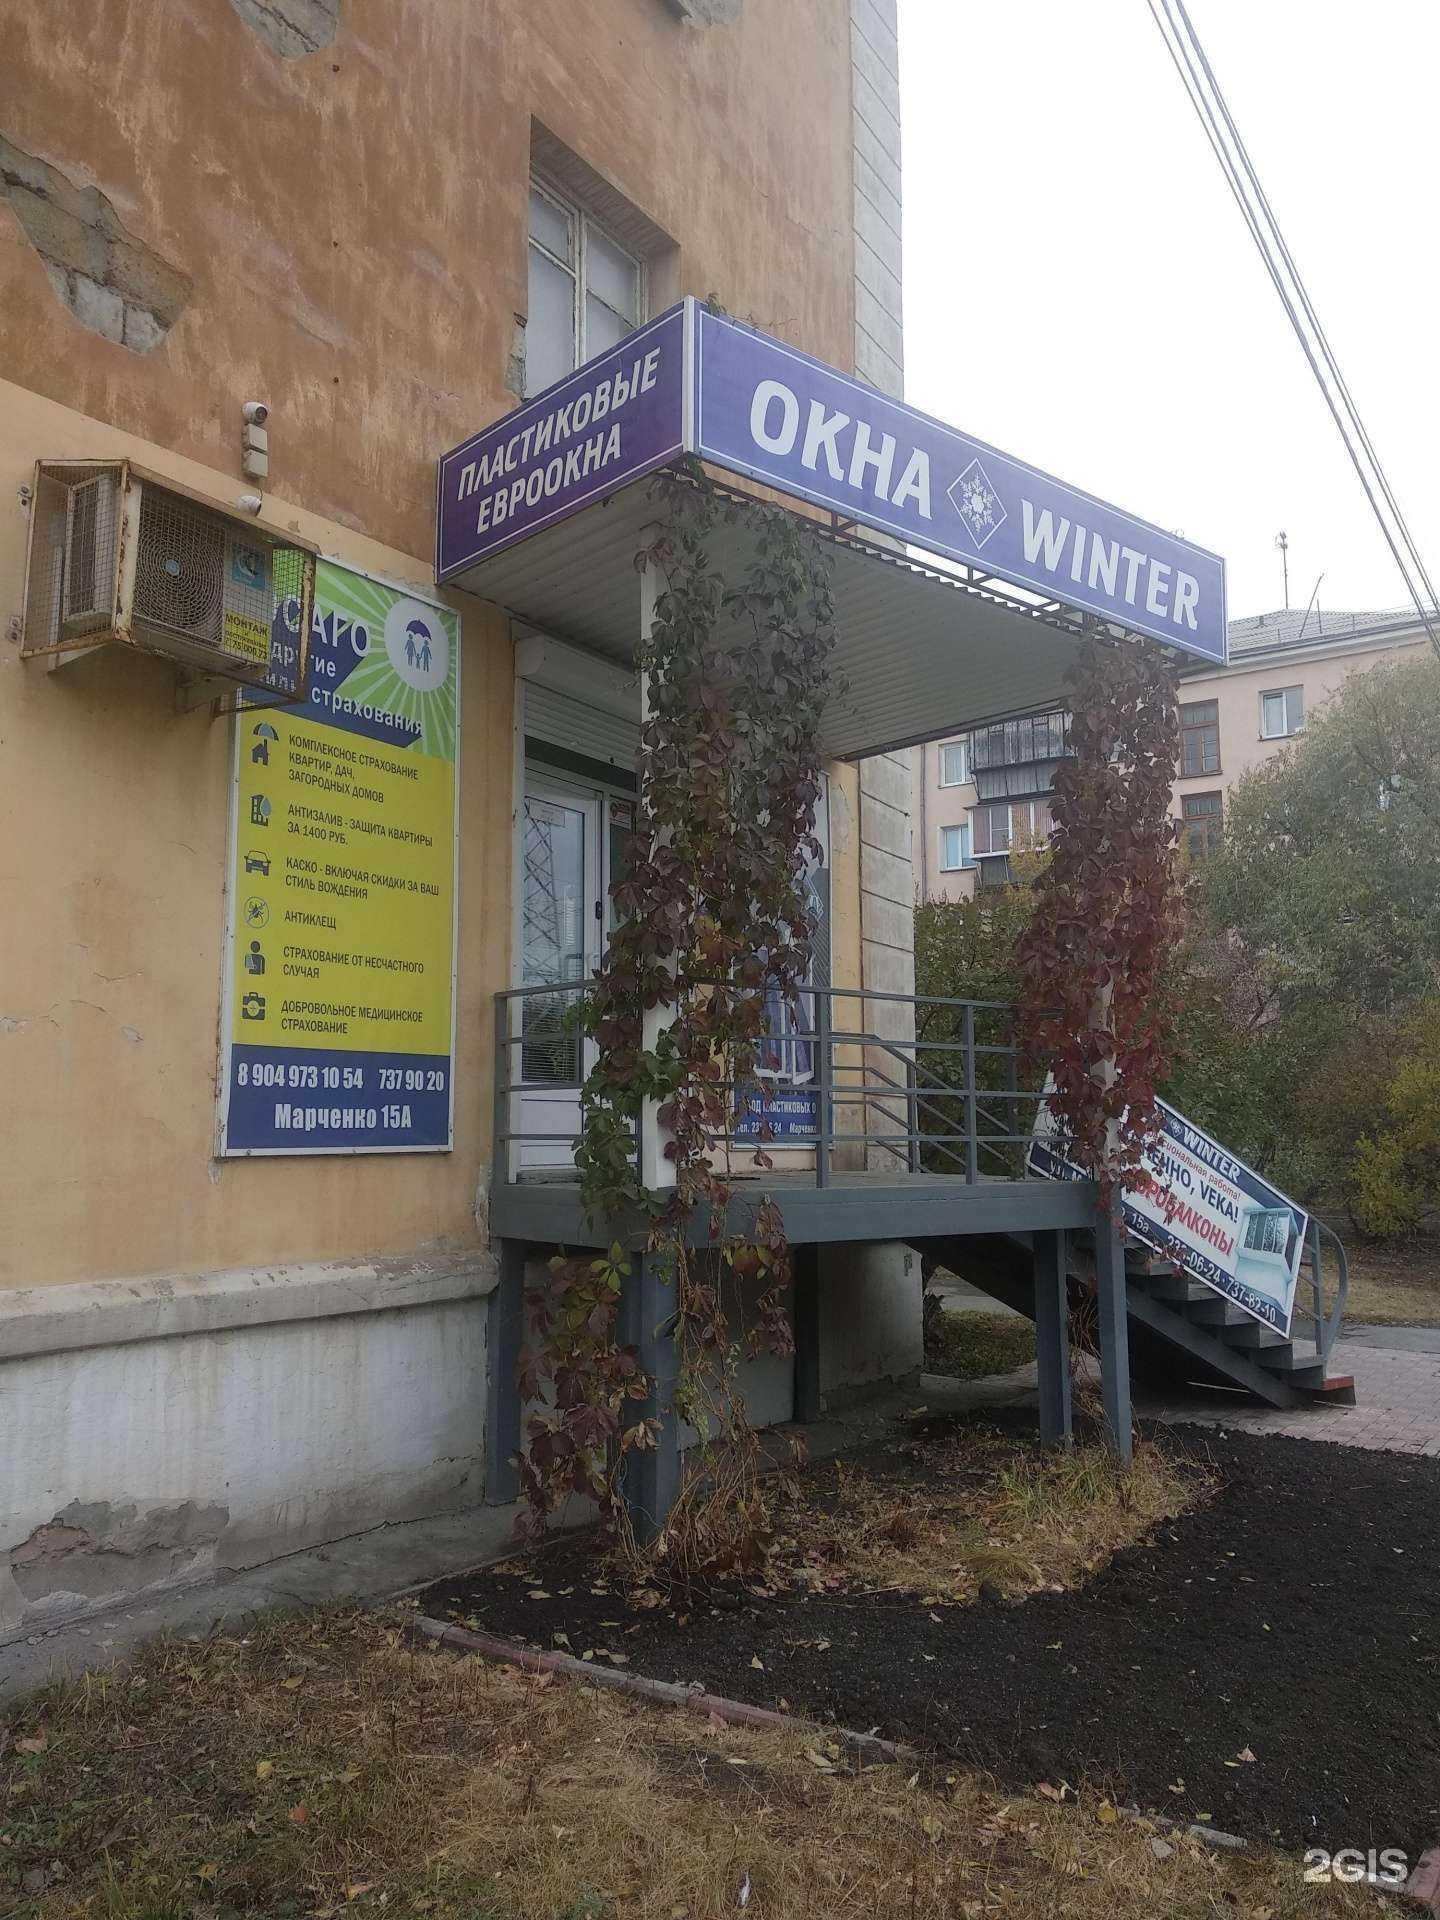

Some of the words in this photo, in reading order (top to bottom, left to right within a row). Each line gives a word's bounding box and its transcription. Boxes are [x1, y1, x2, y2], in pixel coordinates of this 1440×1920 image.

[458, 346, 661, 501] ПЛАСТИКОВЫЕ
[477, 423, 621, 534] ЕВРООКНА
[749, 379, 933, 520] ОКНА
[1021, 499, 1200, 630] WINTER
[311, 686, 422, 734] страхования
[289, 734, 356, 763] КОМПЛЕКСНОЕ
[359, 754, 419, 780] СТРАХОВАНИЕ
[289, 752, 333, 775] КВАРТИР,
[288, 769, 350, 795] ЗАГОРОДНЫХ
[352, 786, 384, 803] ДОМОВ
[288, 804, 342, 827] АНТИЗАЛИВ
[350, 818, 386, 835] ЗАЩИТА
[388, 828, 433, 847] КВАРТИРЫ
[288, 821, 300, 834] ЗА
[303, 825, 327, 840] 1400
[329, 830, 348, 845] РУБ.
[285, 874, 316, 891] СТИЛЬ
[318, 881, 368, 899] ВОЖДЕНИЯ
[286, 856, 317, 873] КАСКО
[325, 865, 369, 883] ВКЛЮЧАЯ
[371, 873, 406, 890] СКИДКИ
[408, 881, 418, 892] ЗА
[421, 883, 439, 896] ВАШ
[284, 910, 336, 930] АНТИКЛЕЩ
[283, 946, 349, 965] СТРАХОВАНИЕ
[352, 955, 363, 966] ОТ
[365, 957, 424, 974] НЕСЧАСТНОГО
[283, 964, 319, 978] СЛУЧАЯ
[281, 1000, 356, 1017] ДОБРОВОЛЬНОЕ
[359, 1007, 423, 1023] МЕДИЦИНСКОЕ
[281, 1018, 348, 1034] СТРАХОВАНИЕ
[237, 1063, 248, 1086] 8
[252, 1064, 285, 1087] 904
[289, 1065, 318, 1088] 973
[322, 1067, 340, 1089] 10
[343, 1068, 363, 1089] 54
[379, 1069, 402, 1090] 737
[405, 1070, 424, 1091] 90
[427, 1071, 444, 1092] 20
[274, 1103, 376, 1131] Марченко
[381, 1105, 412, 1128] 15А
[1182, 1127, 1241, 1183] WINTER
[1208, 1172, 1241, 1201] работа!
[1200, 1182, 1239, 1223] VEKA!
[1224, 1278, 1276, 1323] 737-82-10
